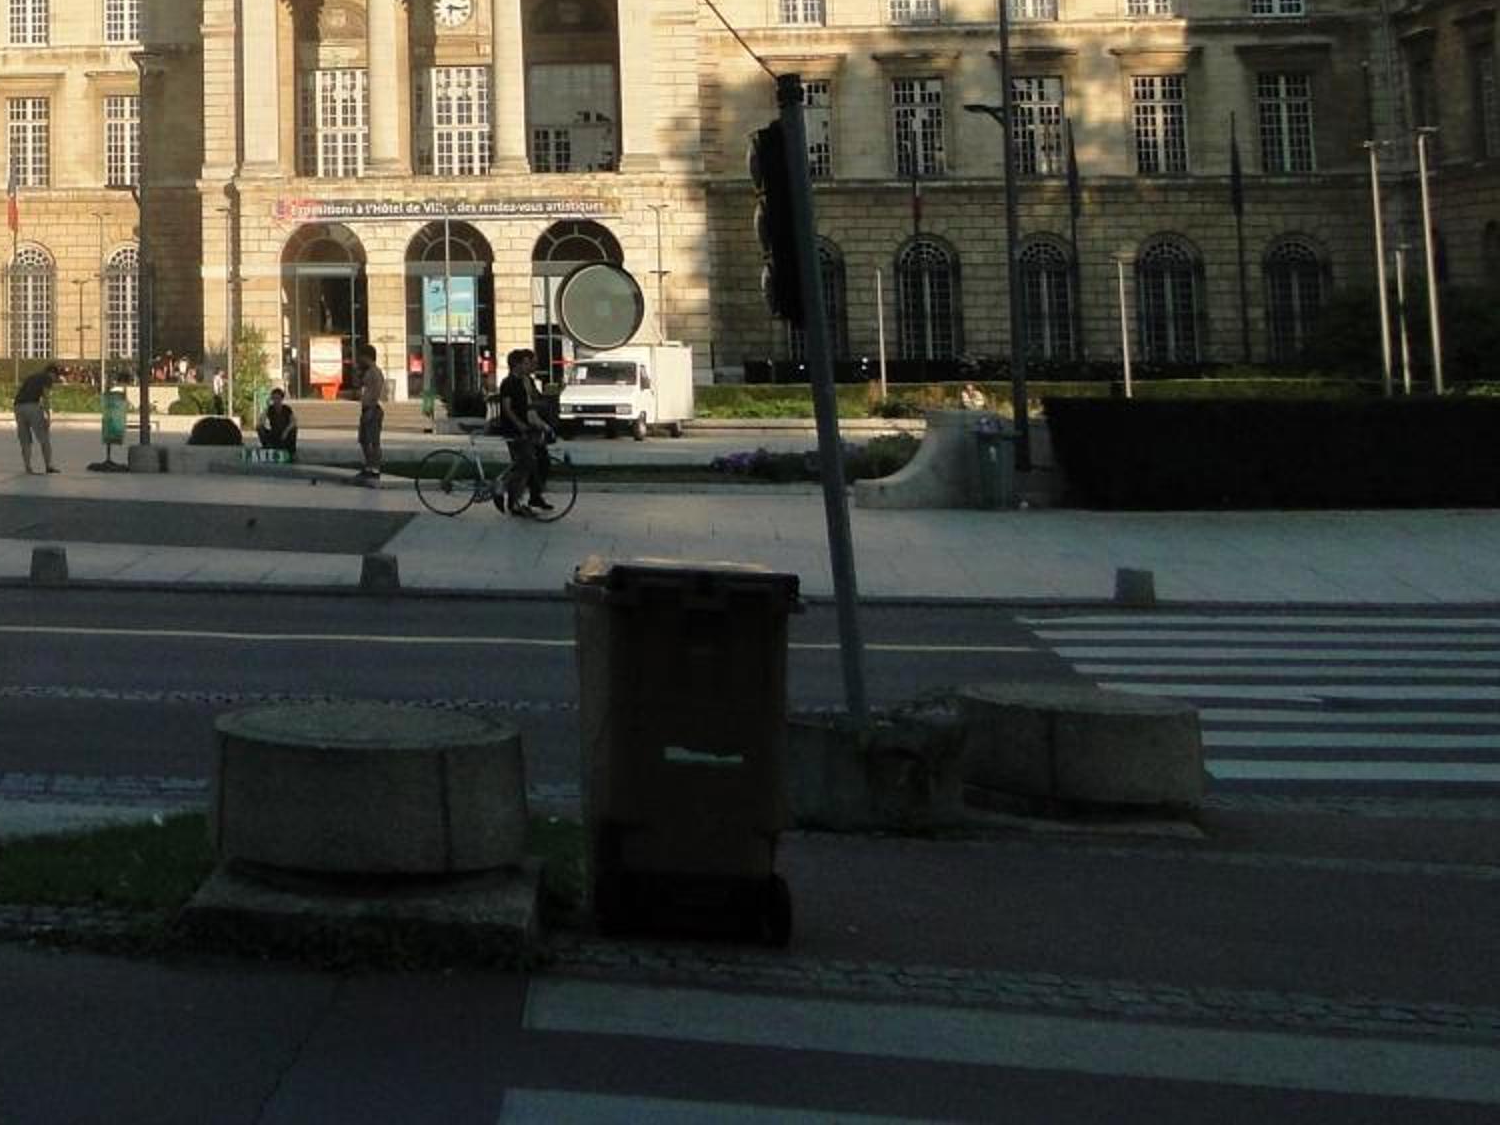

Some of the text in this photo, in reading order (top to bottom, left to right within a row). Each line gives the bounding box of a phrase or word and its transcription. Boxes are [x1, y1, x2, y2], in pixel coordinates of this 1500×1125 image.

[356, 202, 364, 214] à
[366, 200, 404, 214] l'Hôtel
[406, 201, 420, 213] de
[457, 201, 477, 213] des
[479, 200, 543, 212] rendez-vous
[546, 199, 603, 212] artistiques
